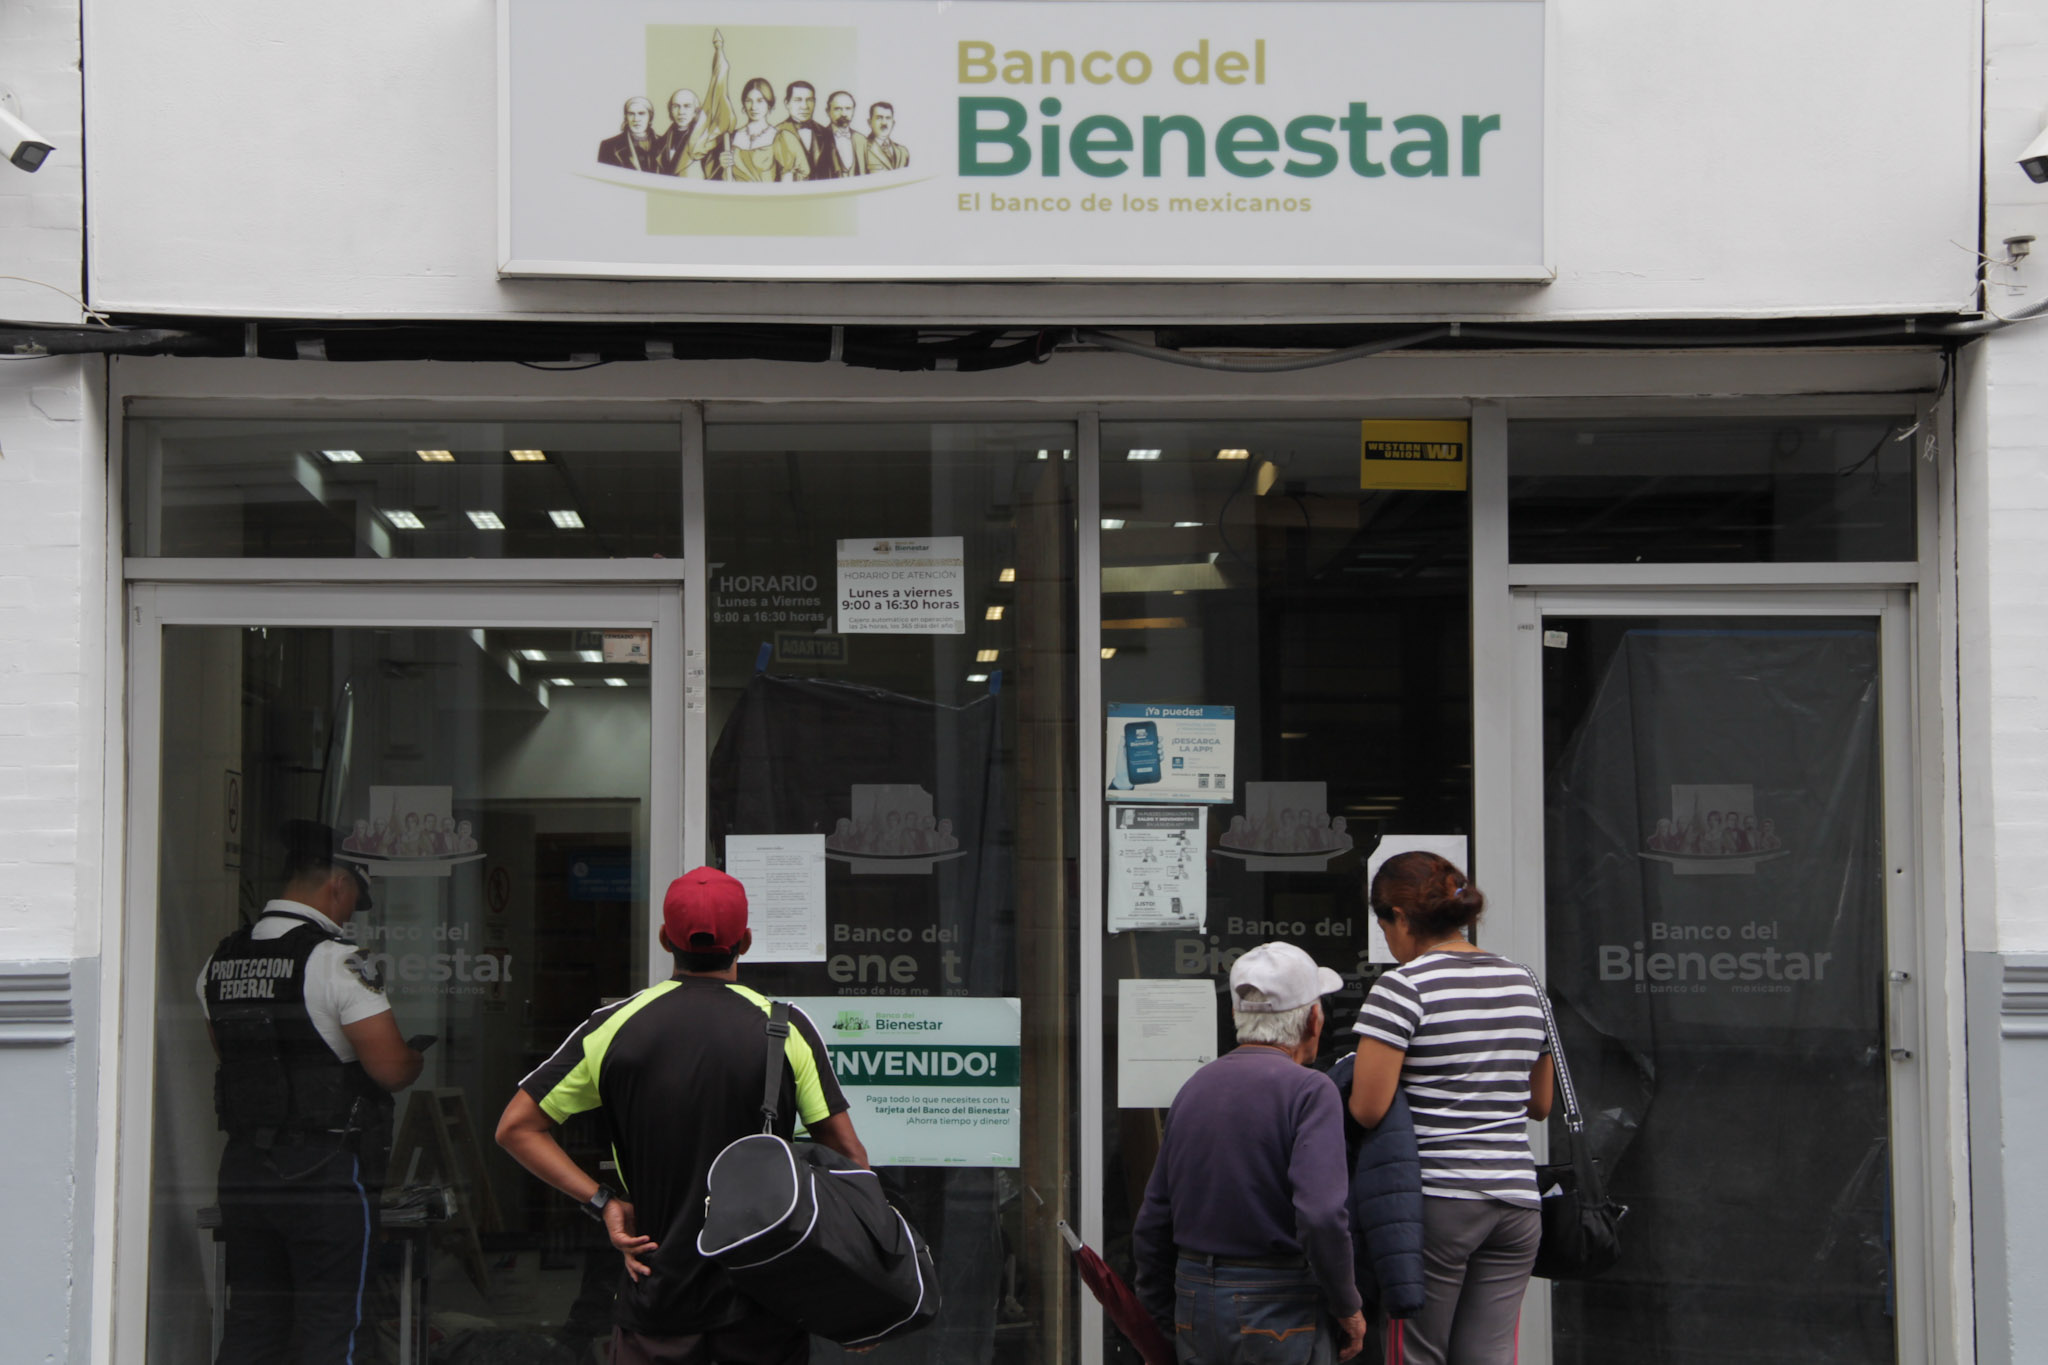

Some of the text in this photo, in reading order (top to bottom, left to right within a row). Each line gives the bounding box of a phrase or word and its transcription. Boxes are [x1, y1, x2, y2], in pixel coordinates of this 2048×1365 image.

[956, 38, 1266, 85] Banco del
[956, 96, 1501, 179] Bienestar
[957, 192, 1312, 212] El banco de los mexicanos
[1368, 443, 1458, 460] WESTERN WU
[1384, 451, 1421, 459] UNION
[844, 570, 957, 580] HORARIO DE ATENCIÓN
[720, 575, 818, 592] HORARIO
[849, 587, 953, 598] Lunes a viernes
[717, 595, 821, 607] Lunes a Viernes
[842, 599, 960, 610] 9:00 a 16:30 horas
[713, 611, 825, 623] 9:00 a 16:30 horas
[1145, 707, 1204, 717] ¡Ya puedes!
[1179, 745, 1213, 753] LA APP!
[341, 921, 423, 942] Banco
[432, 921, 470, 942] del
[1227, 916, 1352, 936] Banco del
[1651, 921, 1778, 940] Banco del
[833, 923, 959, 943] Banco del
[1598, 941, 1833, 982] Bienestar
[210, 957, 295, 981] PROTECCION
[219, 977, 276, 1001] FEDERAL
[870, 985, 887, 997] de
[889, 985, 907, 997] los
[1650, 983, 1688, 993] banco
[1691, 983, 1707, 993] de
[902, 1011, 915, 1019] del
[875, 1019, 943, 1031] Bienestar
[866, 1095, 1010, 1105] Paga todo lo que necesites con tu
[875, 1106, 1010, 1116] tarjeta del Banco del Bienestar
[906, 1117, 1010, 1128] ¡Ahorra tiempo y dinero!
